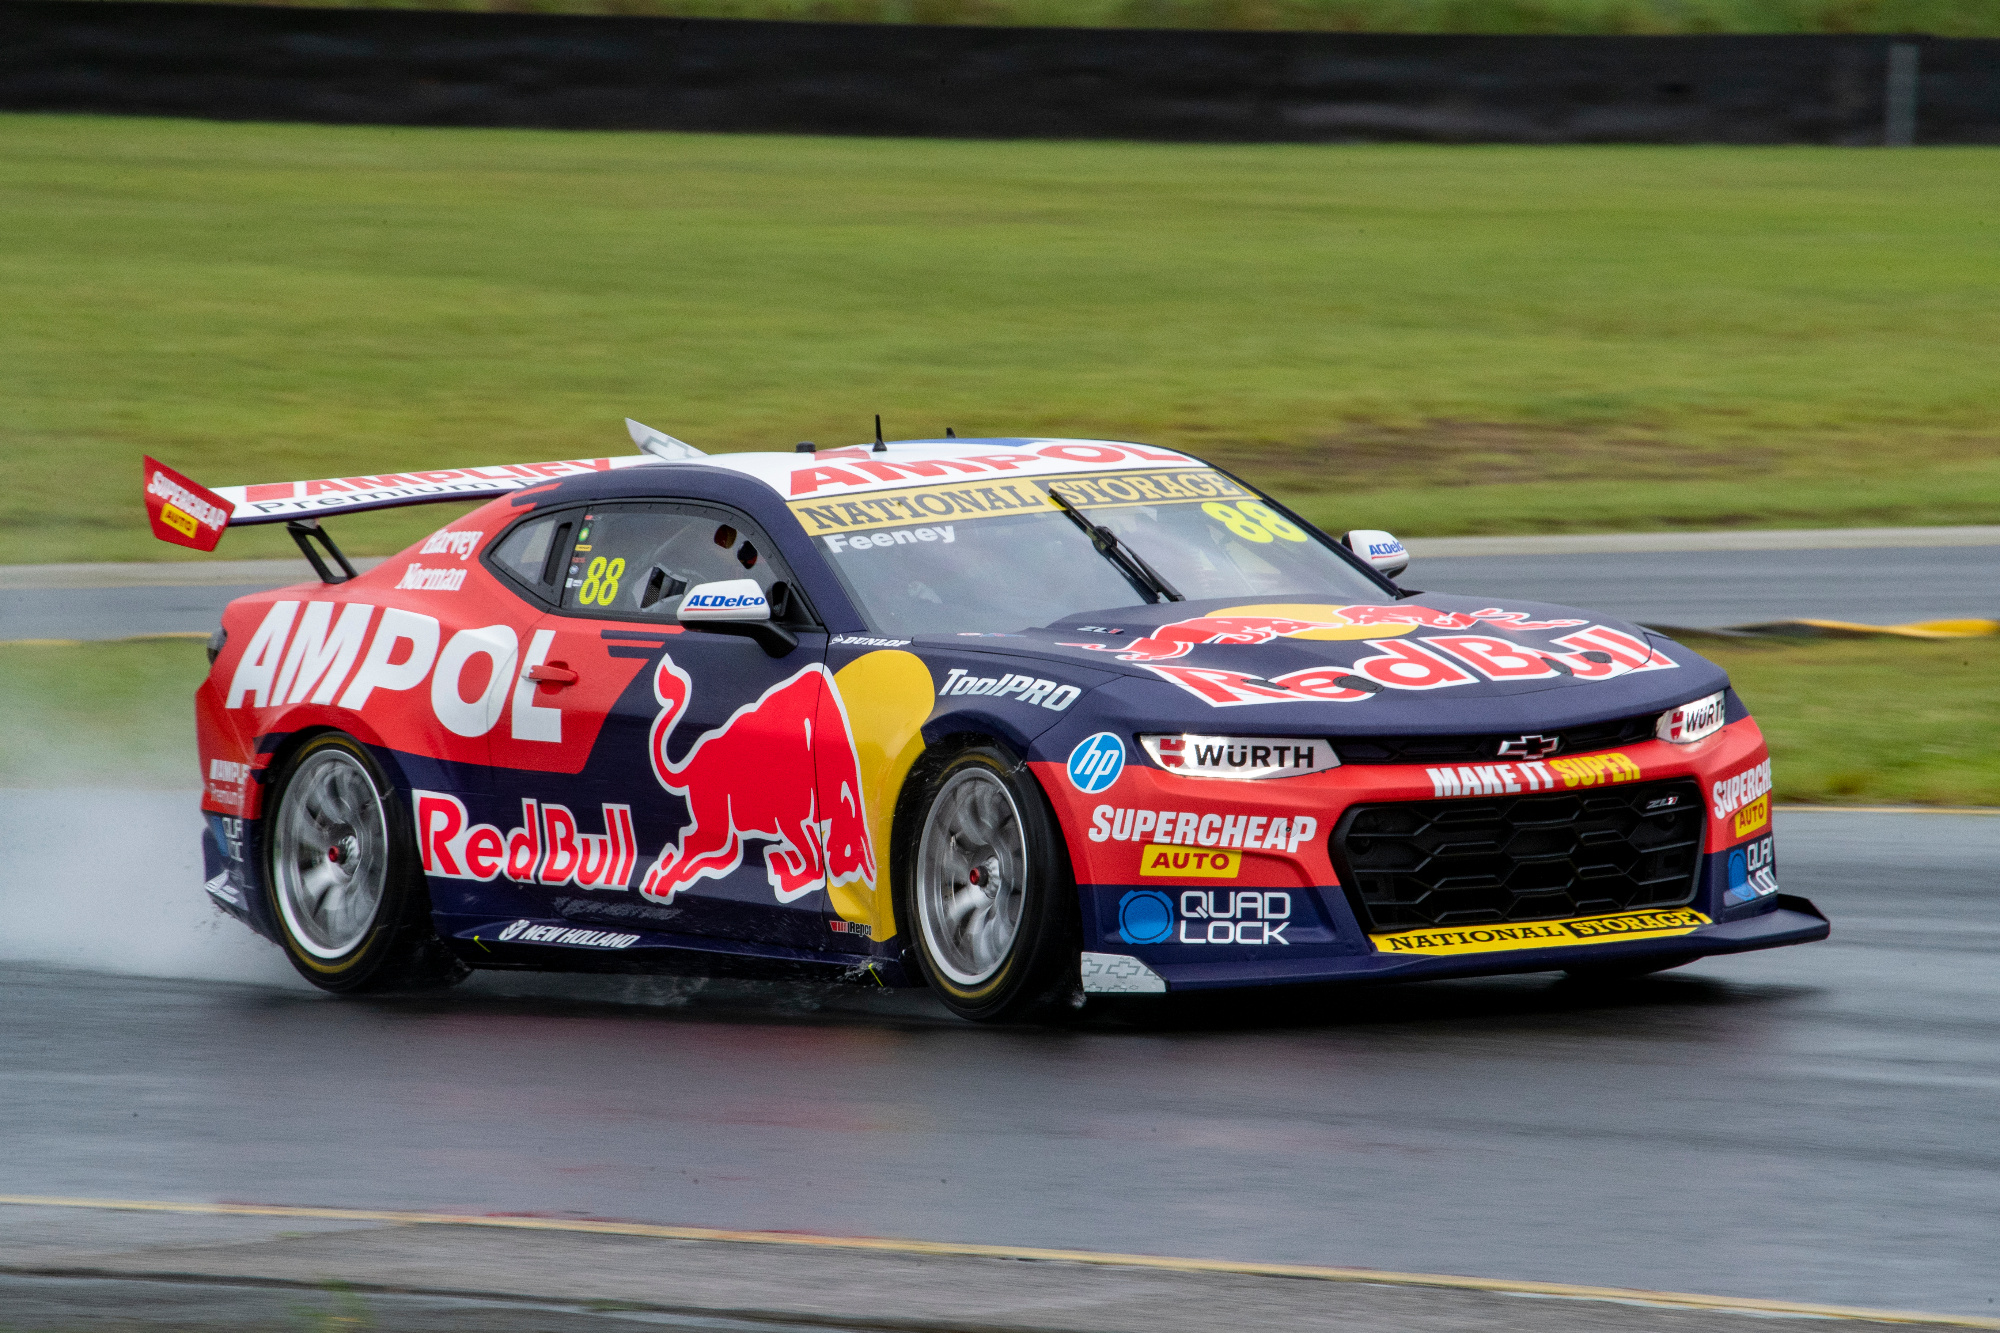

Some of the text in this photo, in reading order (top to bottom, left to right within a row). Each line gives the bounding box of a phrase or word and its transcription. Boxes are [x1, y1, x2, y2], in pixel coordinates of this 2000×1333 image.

[306, 458, 611, 496] AMPLIFY
[790, 444, 1191, 495] AMPOL
[147, 471, 227, 531] SUPERCHEAP
[252, 482, 499, 513] Premium
[797, 473, 1242, 530] NATIONAL STORAGE
[165, 510, 193, 531] AUTO
[1201, 501, 1308, 543] 88
[419, 528, 484, 560] Harvey
[822, 525, 956, 553] Feeney
[1369, 540, 1404, 555] ACDelc
[394, 563, 467, 591] Norman
[579, 556, 626, 606] 88
[687, 595, 765, 607] ACDelco
[841, 637, 911, 647] DUNLOP
[225, 601, 562, 743] AMPOL
[1074, 733, 1119, 791] hp
[1426, 752, 1641, 797] MAKE IT SUPER
[1089, 804, 1317, 853] SUPERCHEAP
[1740, 802, 1765, 829] AUTO
[1151, 853, 1229, 870] AUTO
[1180, 890, 1291, 919] QUAD
[519, 924, 641, 948] NEW HOLLAND
[849, 922, 872, 937] Repco
[1180, 920, 1291, 945] LOCK
[1386, 911, 1700, 951] NATIONAL STORAGE
